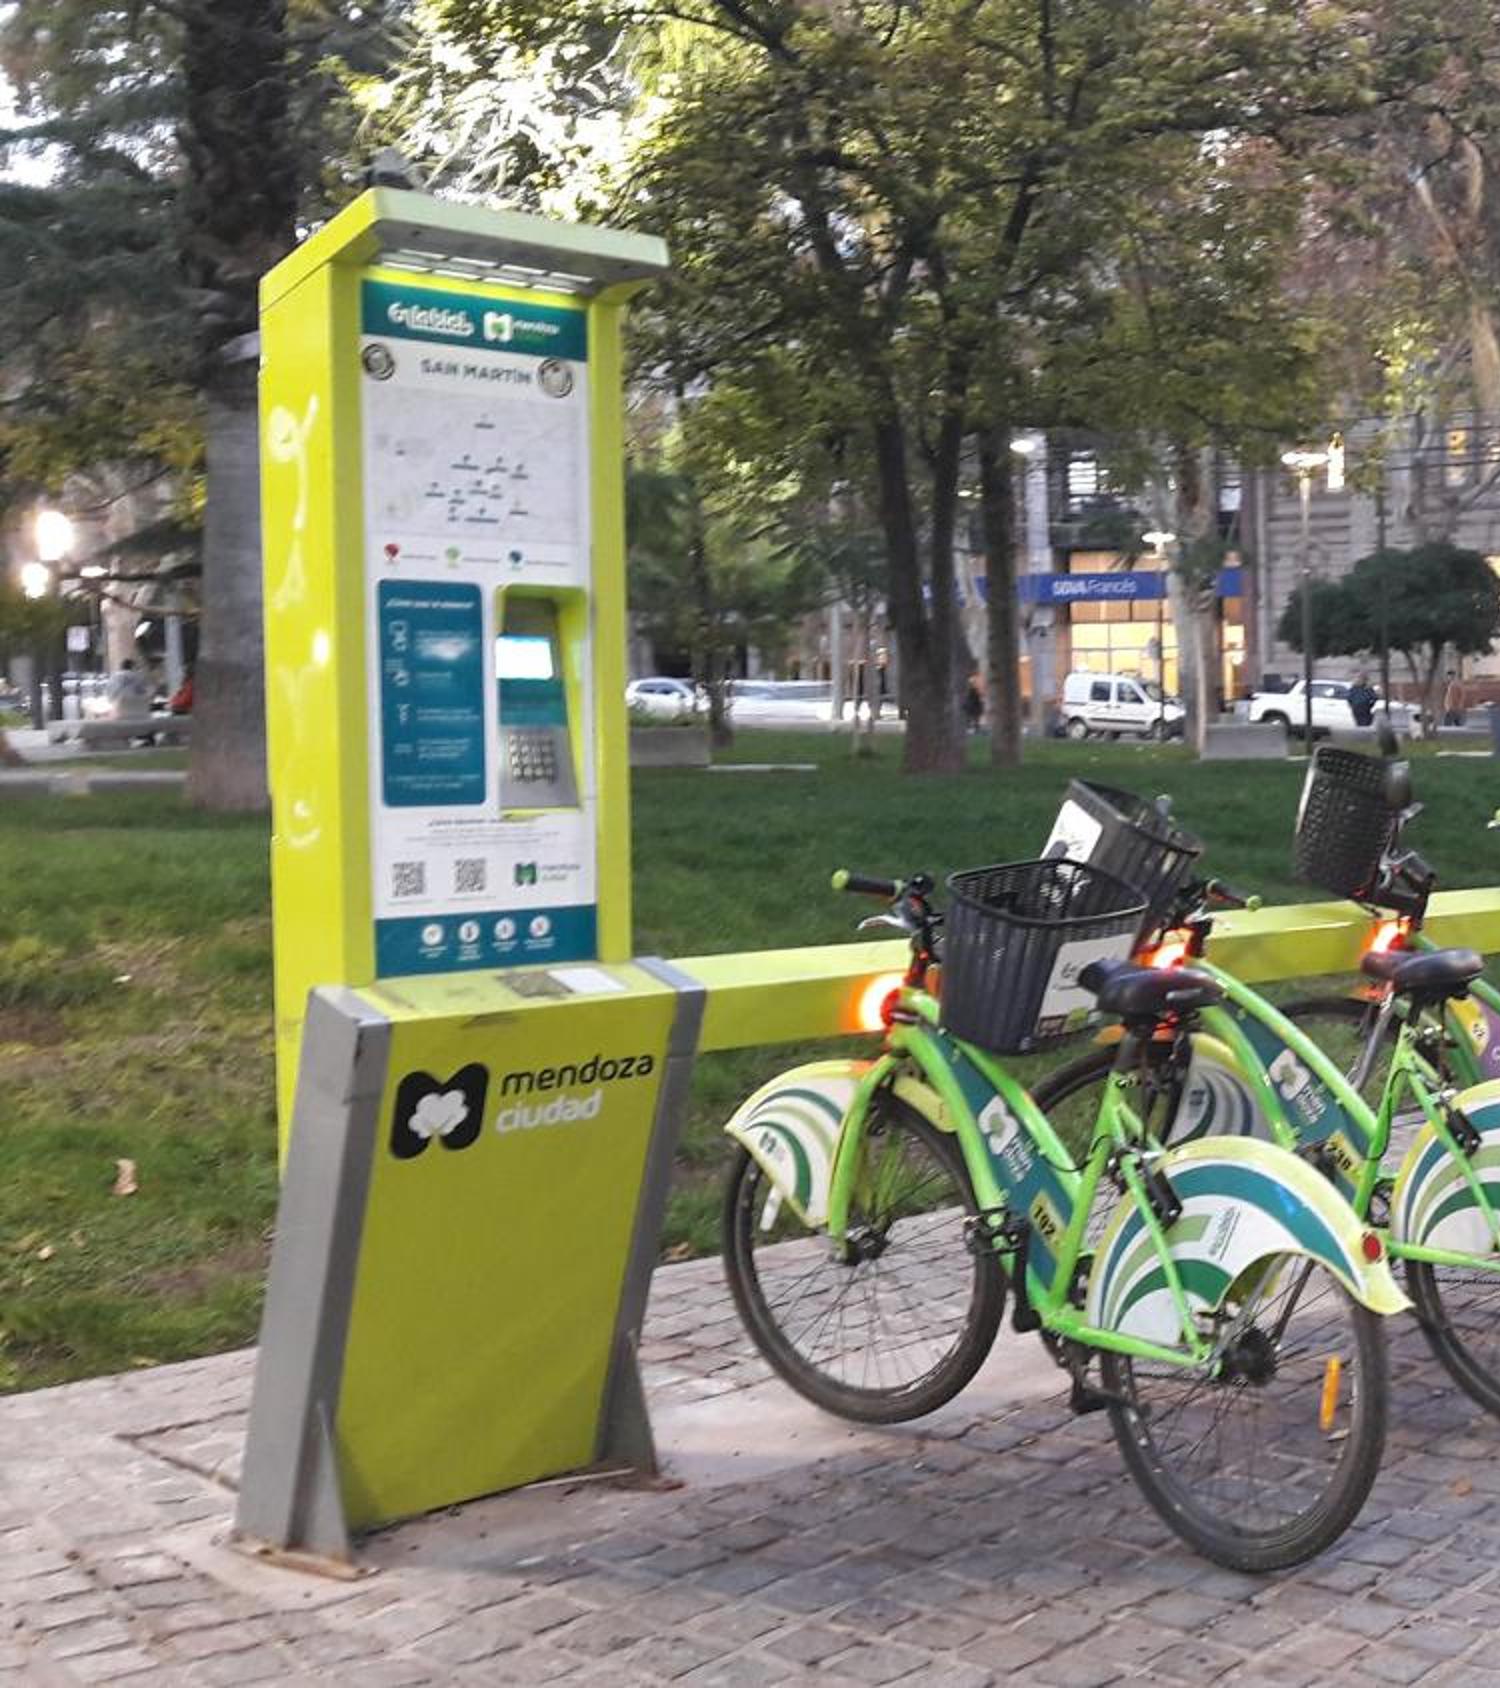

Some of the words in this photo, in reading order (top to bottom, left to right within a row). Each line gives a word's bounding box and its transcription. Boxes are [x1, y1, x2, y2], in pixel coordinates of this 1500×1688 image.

[420, 358, 458, 376] SAN
[500, 1053, 655, 1097] mendoza
[496, 1089, 602, 1135] ciudad
